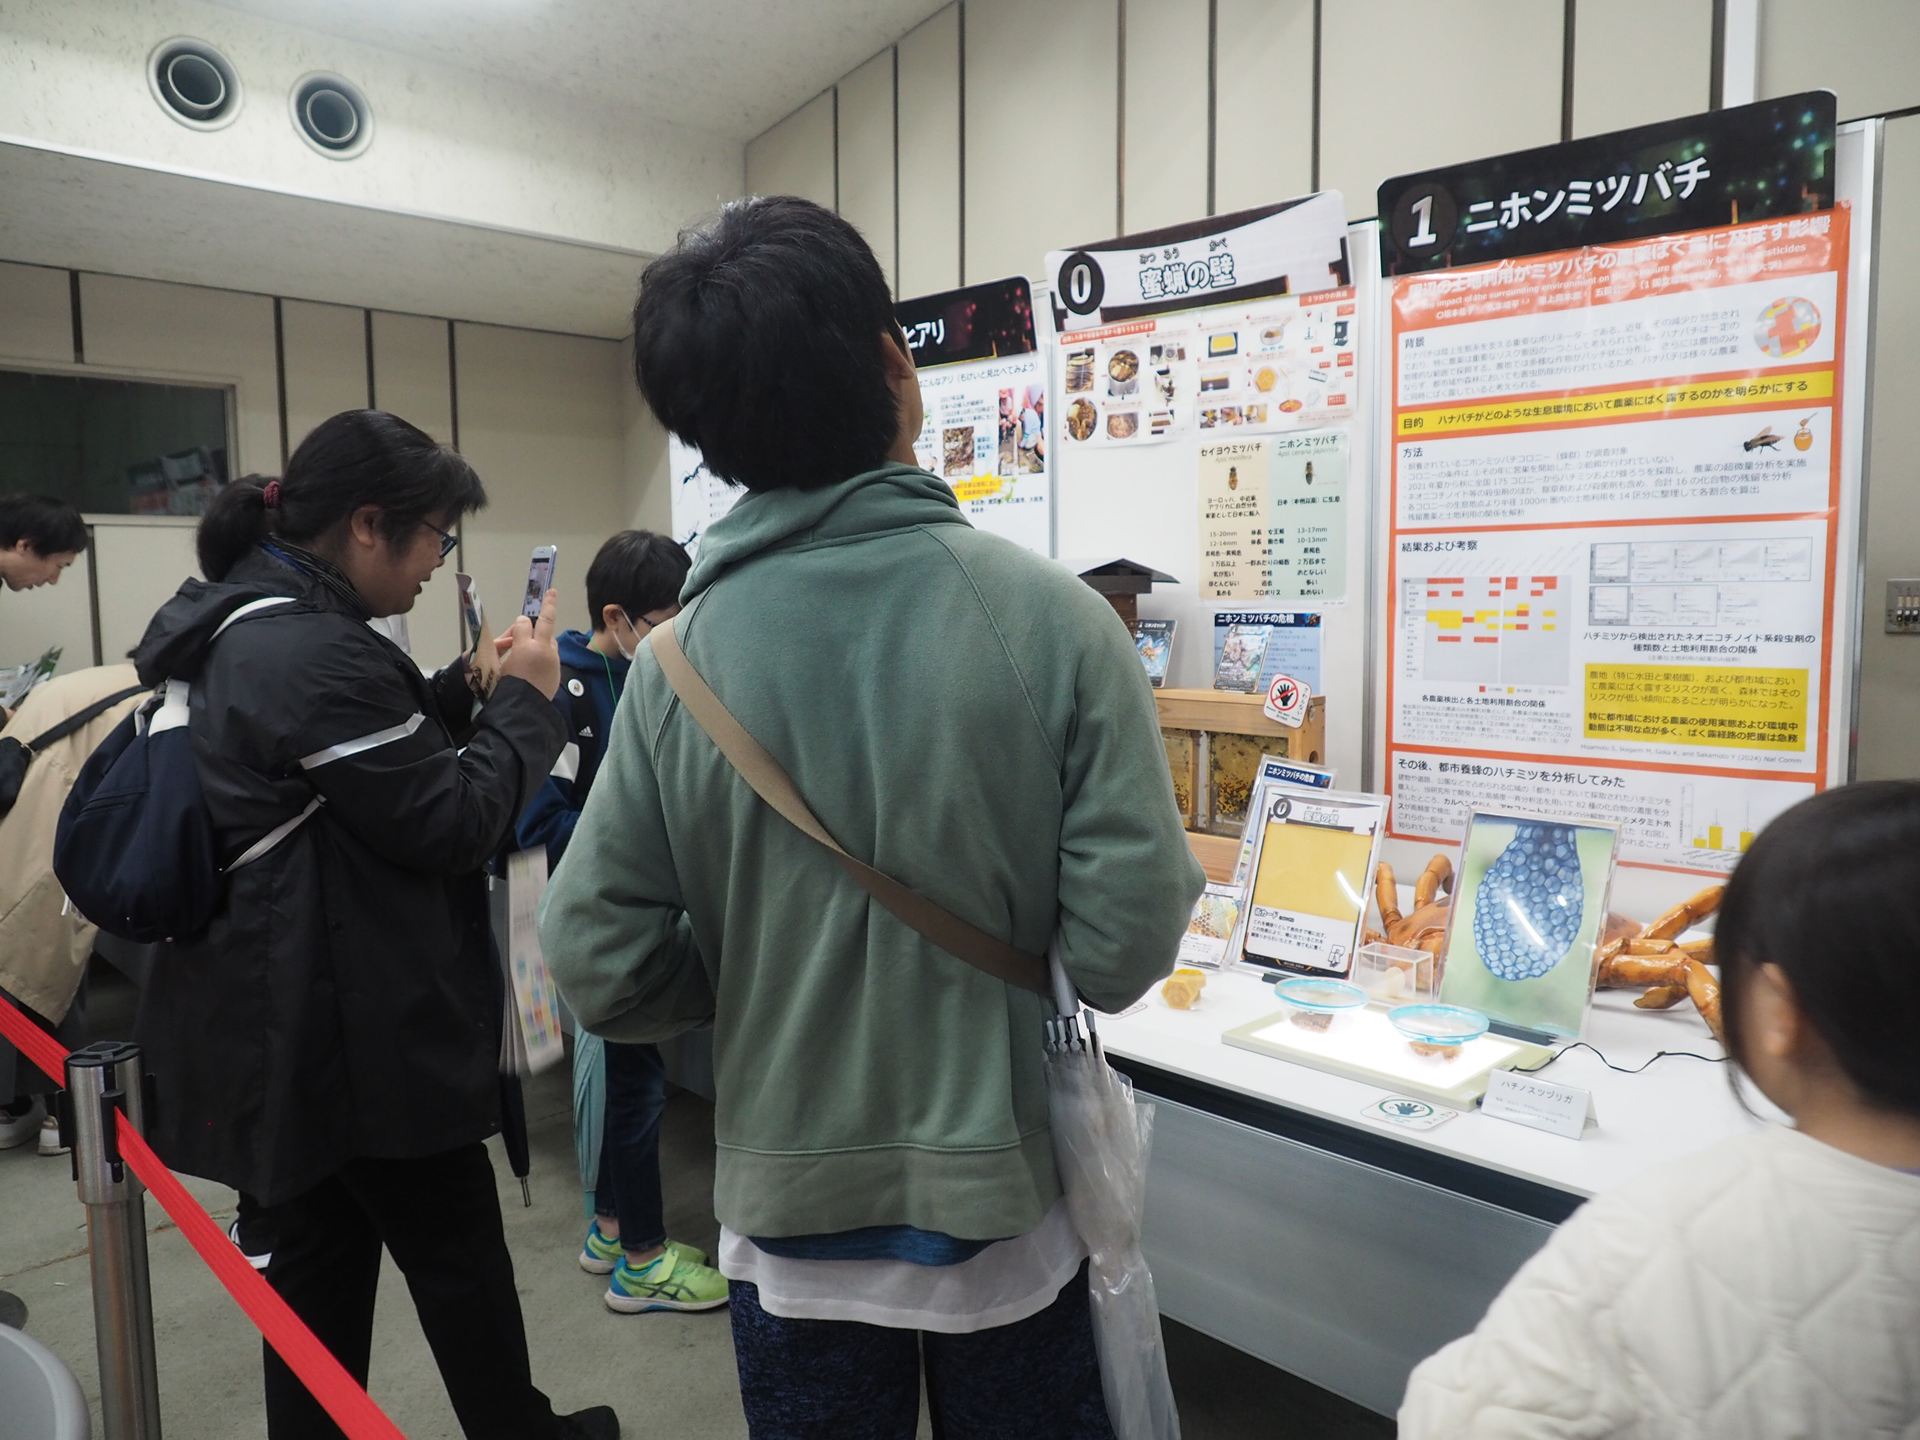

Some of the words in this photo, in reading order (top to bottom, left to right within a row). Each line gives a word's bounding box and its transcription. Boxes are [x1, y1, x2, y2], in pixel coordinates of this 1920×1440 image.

[1408, 196, 1437, 247] 1
[1466, 156, 1711, 234] ニホンミツバチ
[1070, 264, 1092, 304] 0
[1405, 337, 1425, 349] 背景
[1403, 417, 1424, 430] 目的
[1201, 443, 1262, 456] セイヨウミツバチ
[1279, 436, 1338, 449] ニホンミツバチ
[1402, 447, 1423, 458] 方法
[1401, 540, 1478, 553] 結果および考察
[1218, 613, 1295, 624] ニホンミツバチの危機
[1584, 632, 1816, 644] ハチミツから検出されたネオニコチノイド系殺虫剤の
[1398, 759, 1626, 788] その後、都市養蜂のハチミツを分析してみた
